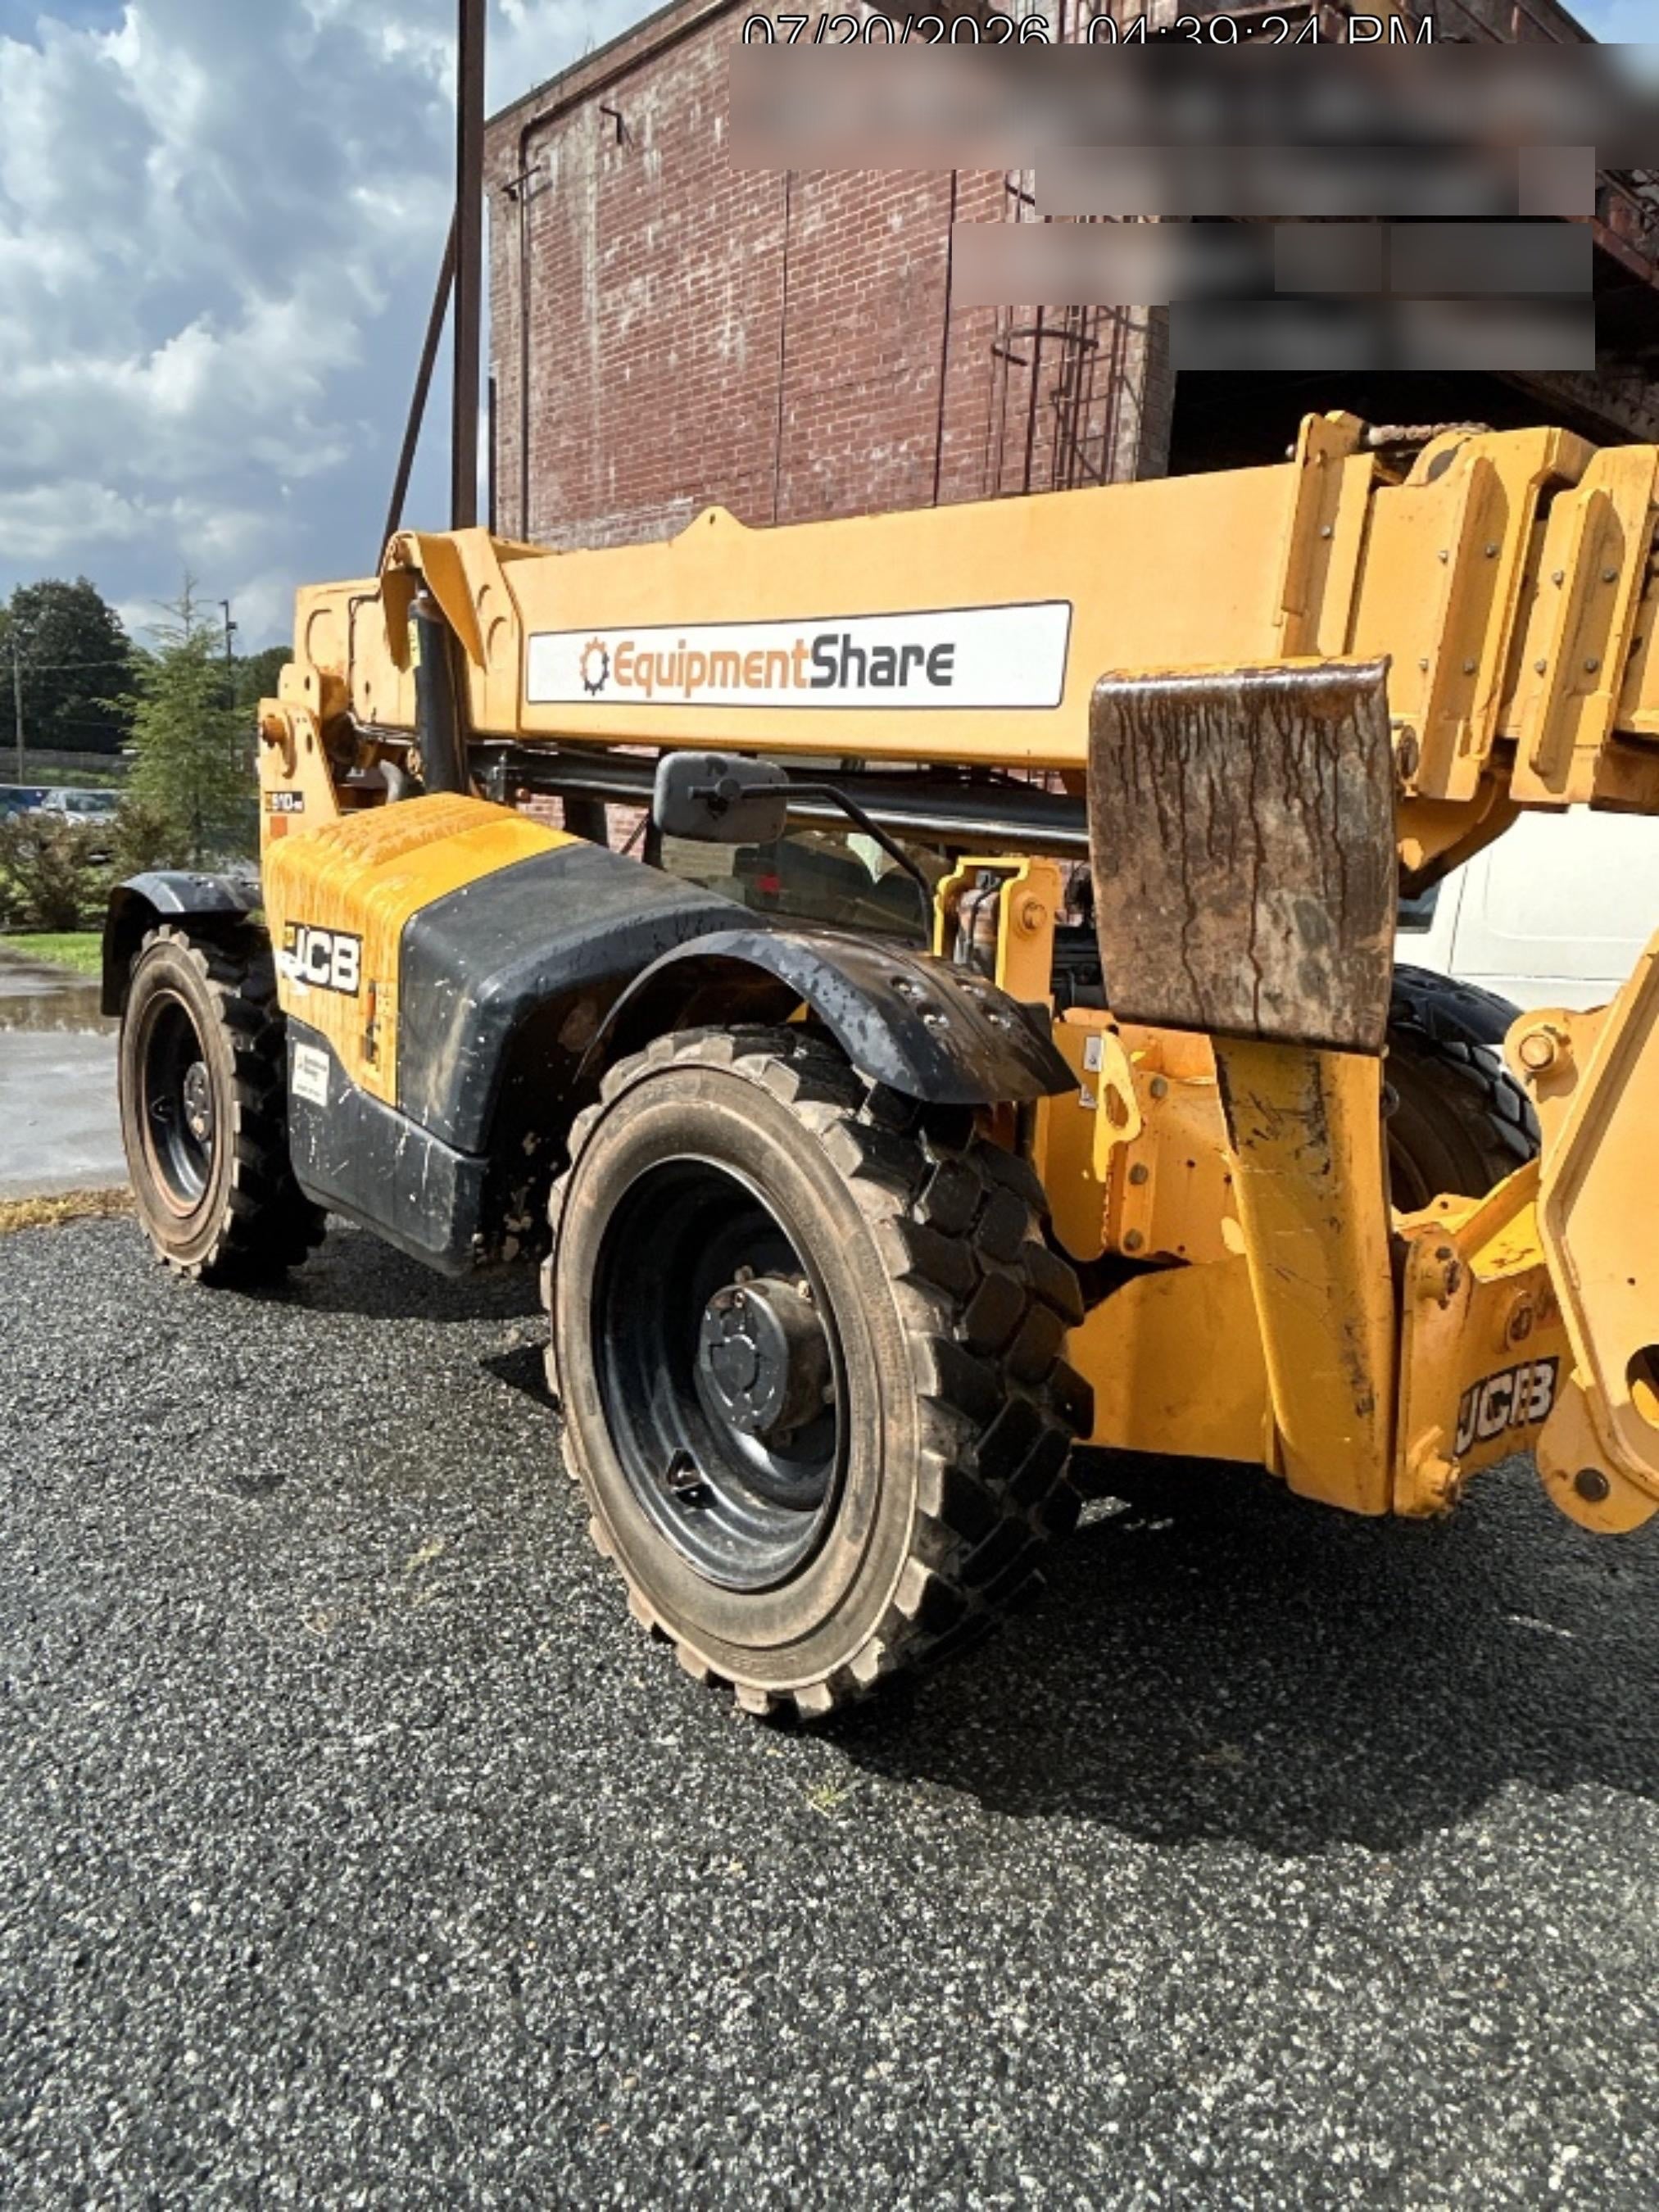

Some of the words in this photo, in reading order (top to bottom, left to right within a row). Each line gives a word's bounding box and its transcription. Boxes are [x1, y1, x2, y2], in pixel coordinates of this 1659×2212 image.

[613, 633, 955, 698] EquipmentShare
[283, 927, 359, 992] JCB
[1455, 1362, 1555, 1452] JCB
